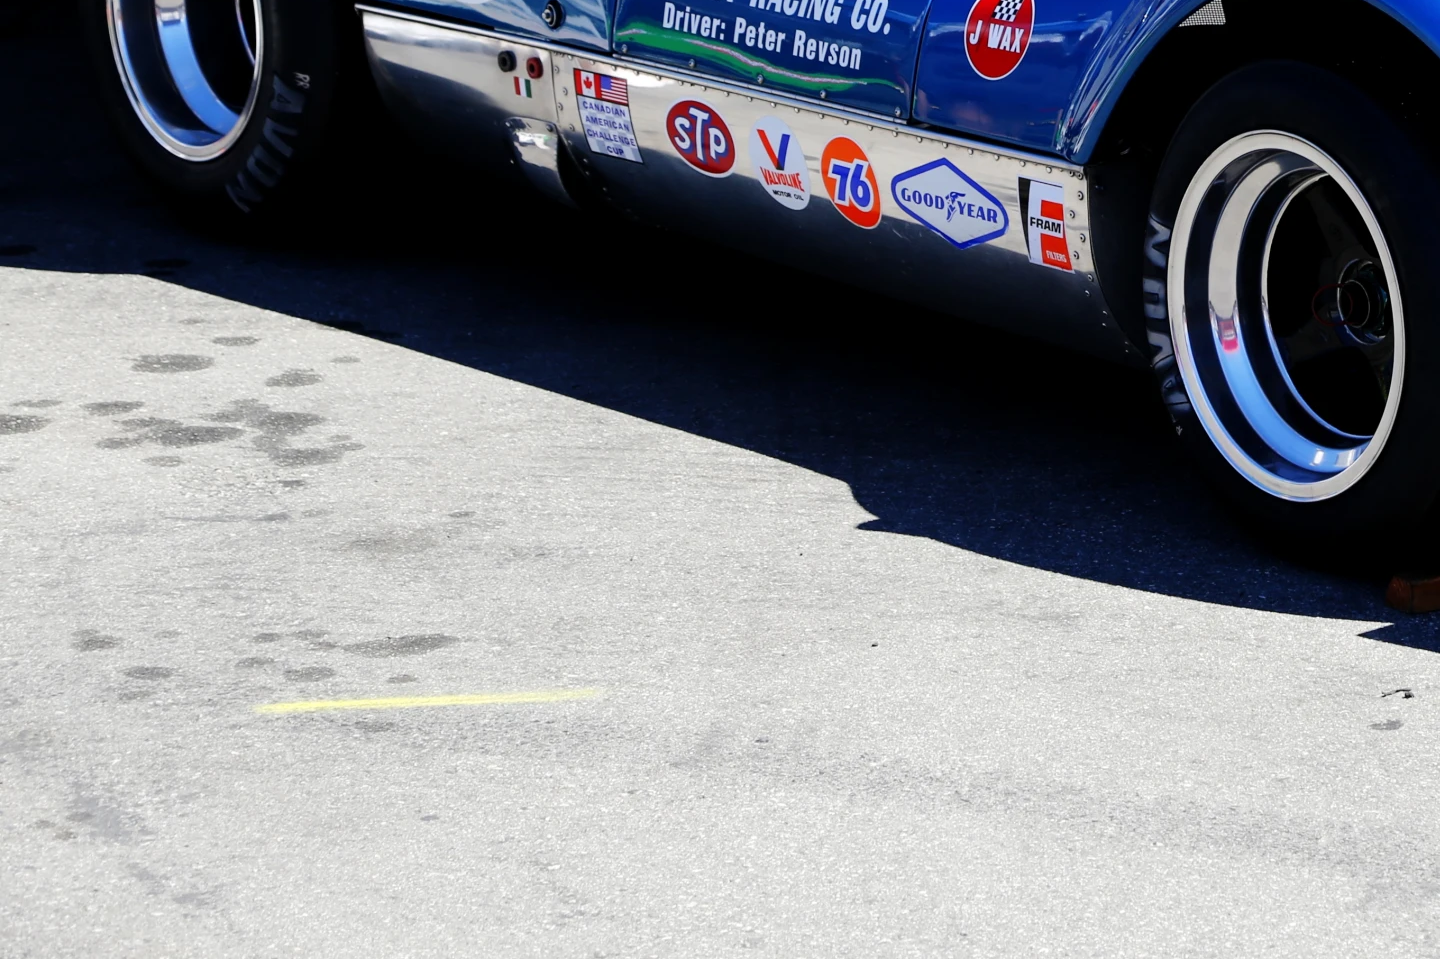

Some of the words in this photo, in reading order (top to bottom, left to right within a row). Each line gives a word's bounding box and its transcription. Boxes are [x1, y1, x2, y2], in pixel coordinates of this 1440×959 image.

[662, 1, 727, 41] Driver:
[733, 16, 787, 54] Peter
[792, 29, 862, 71] Revson
[969, 19, 984, 45] J
[987, 23, 1025, 54] WAX
[582, 101, 626, 118] CANADIAN
[585, 115, 631, 132] AMERICAN
[586, 128, 636, 147] CHALLENGE
[674, 106, 727, 163] STP
[606, 145, 624, 156] CUP
[759, 165, 805, 193] VALVOLINE
[828, 157, 872, 214] 76
[772, 189, 792, 199] MOTOR
[793, 193, 805, 201] OIL
[1029, 216, 1062, 234] FRAM
[1045, 249, 1068, 263] FILTERS
